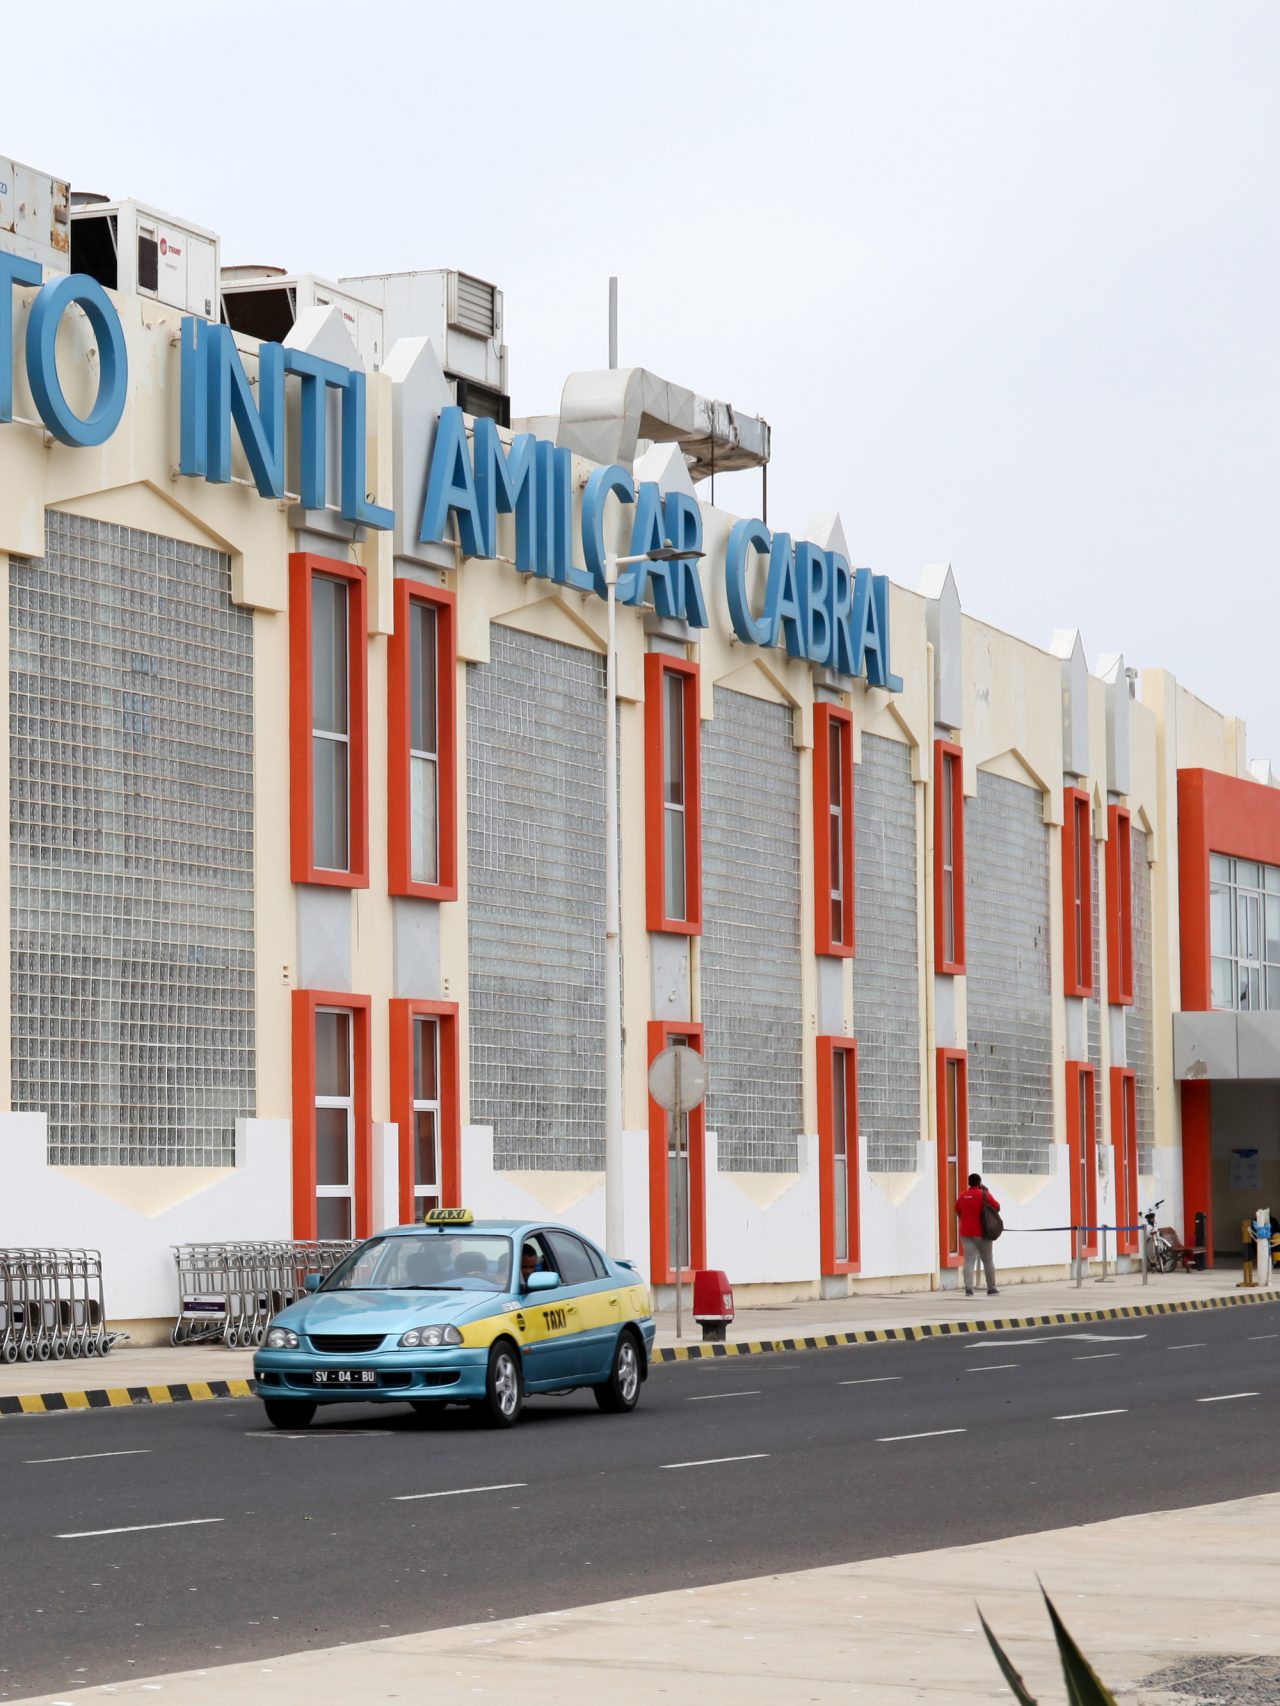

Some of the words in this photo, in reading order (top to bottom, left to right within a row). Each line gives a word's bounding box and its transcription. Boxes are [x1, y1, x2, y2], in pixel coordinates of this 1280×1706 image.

[180, 316, 395, 531] INTL
[420, 406, 709, 628] AMILCAR
[725, 518, 903, 692] CABRAL
[432, 1210, 465, 1219] TAXI
[543, 1309, 567, 1331] TAXI
